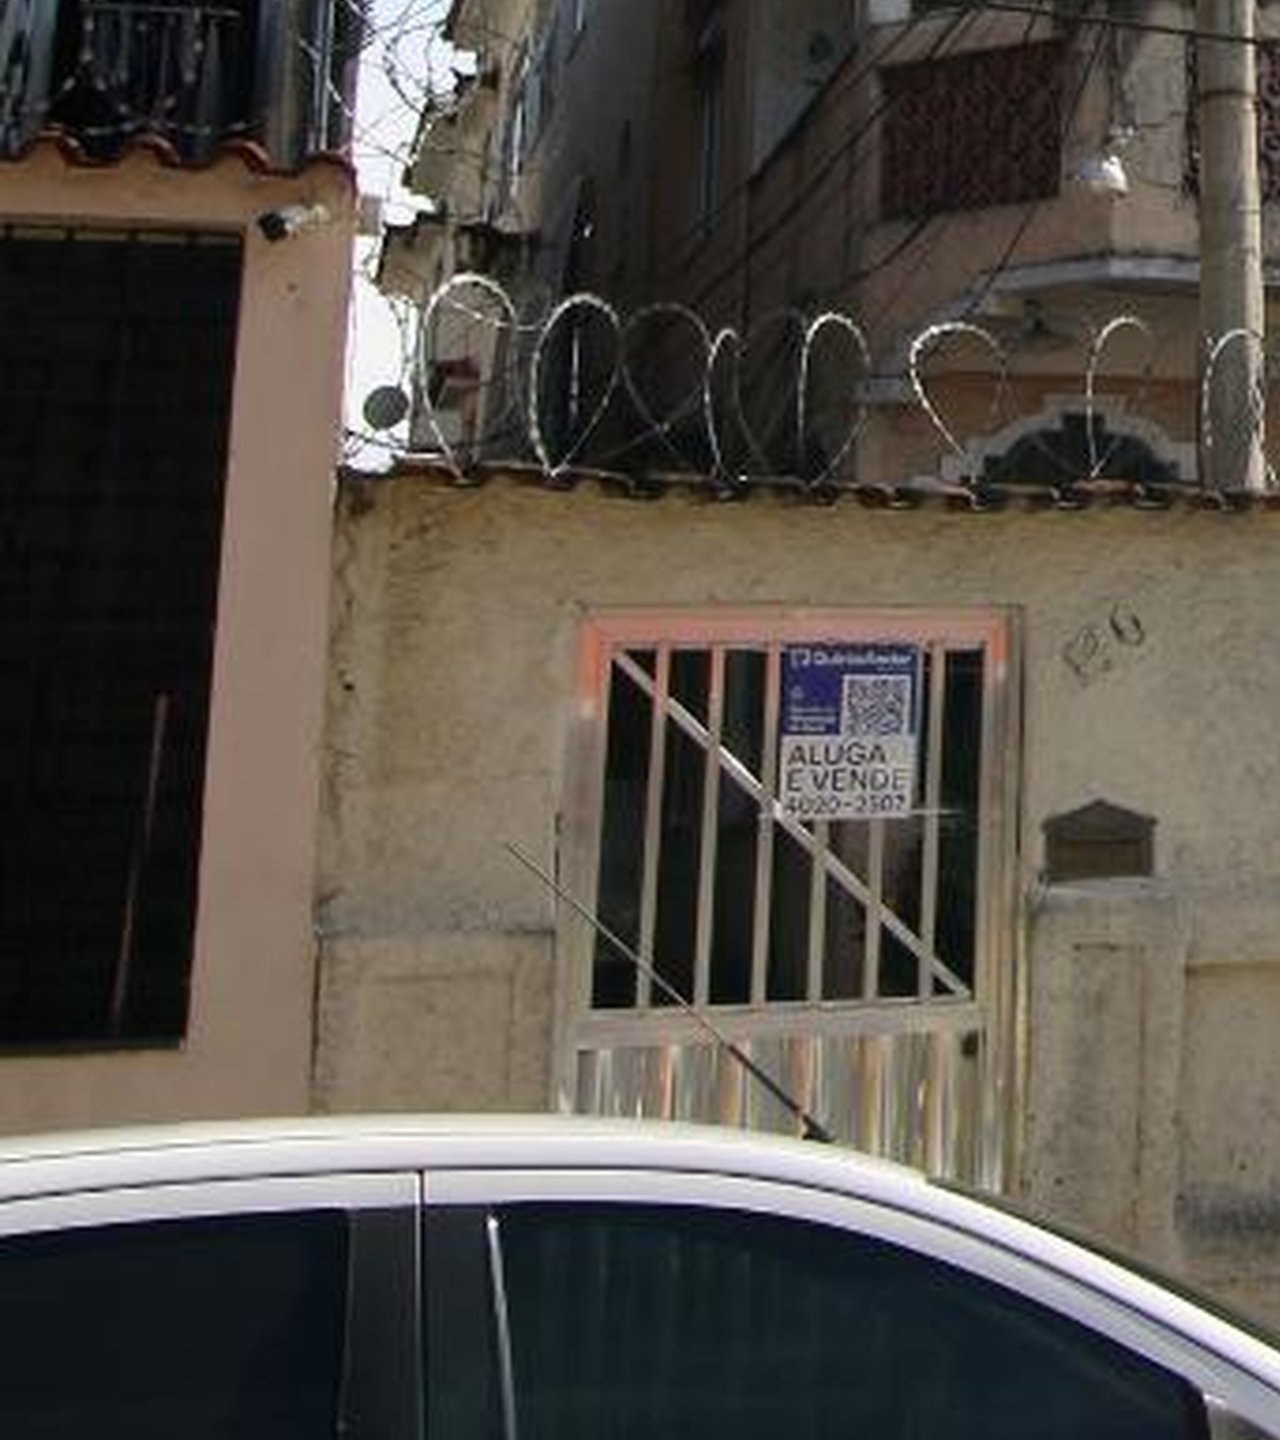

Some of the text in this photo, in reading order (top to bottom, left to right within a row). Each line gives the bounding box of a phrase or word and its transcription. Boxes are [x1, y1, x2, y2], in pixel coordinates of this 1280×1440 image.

[787, 743, 886, 767] ALUGA
[787, 768, 909, 792] E VENDE
